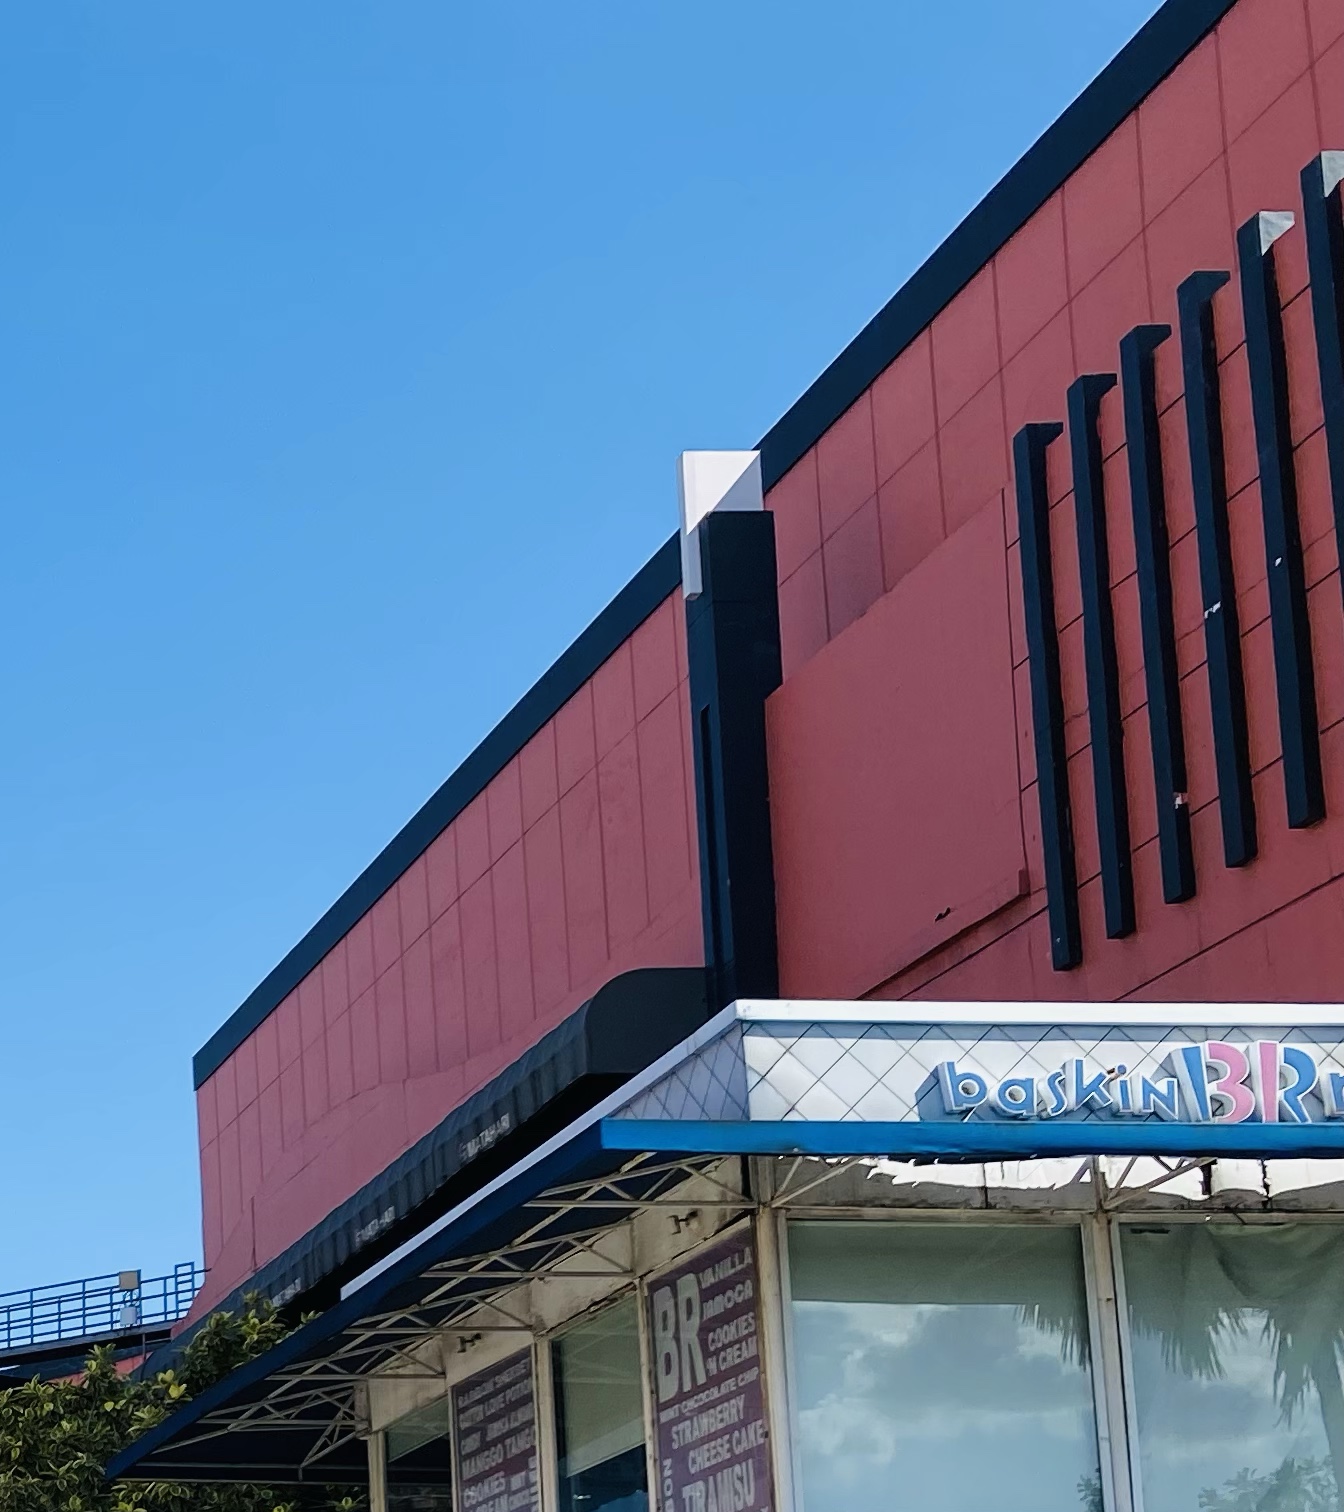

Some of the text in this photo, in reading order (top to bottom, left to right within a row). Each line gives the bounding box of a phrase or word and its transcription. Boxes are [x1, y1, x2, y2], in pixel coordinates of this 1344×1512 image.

[941, 1056, 1179, 1119] baskin
[653, 1272, 707, 1403] BR
[708, 1312, 756, 1351] COOKIES
[719, 1335, 758, 1372] CREAM
[671, 1394, 746, 1450] STRAWBERRY
[688, 1419, 764, 1475] CHEESE CAKE
